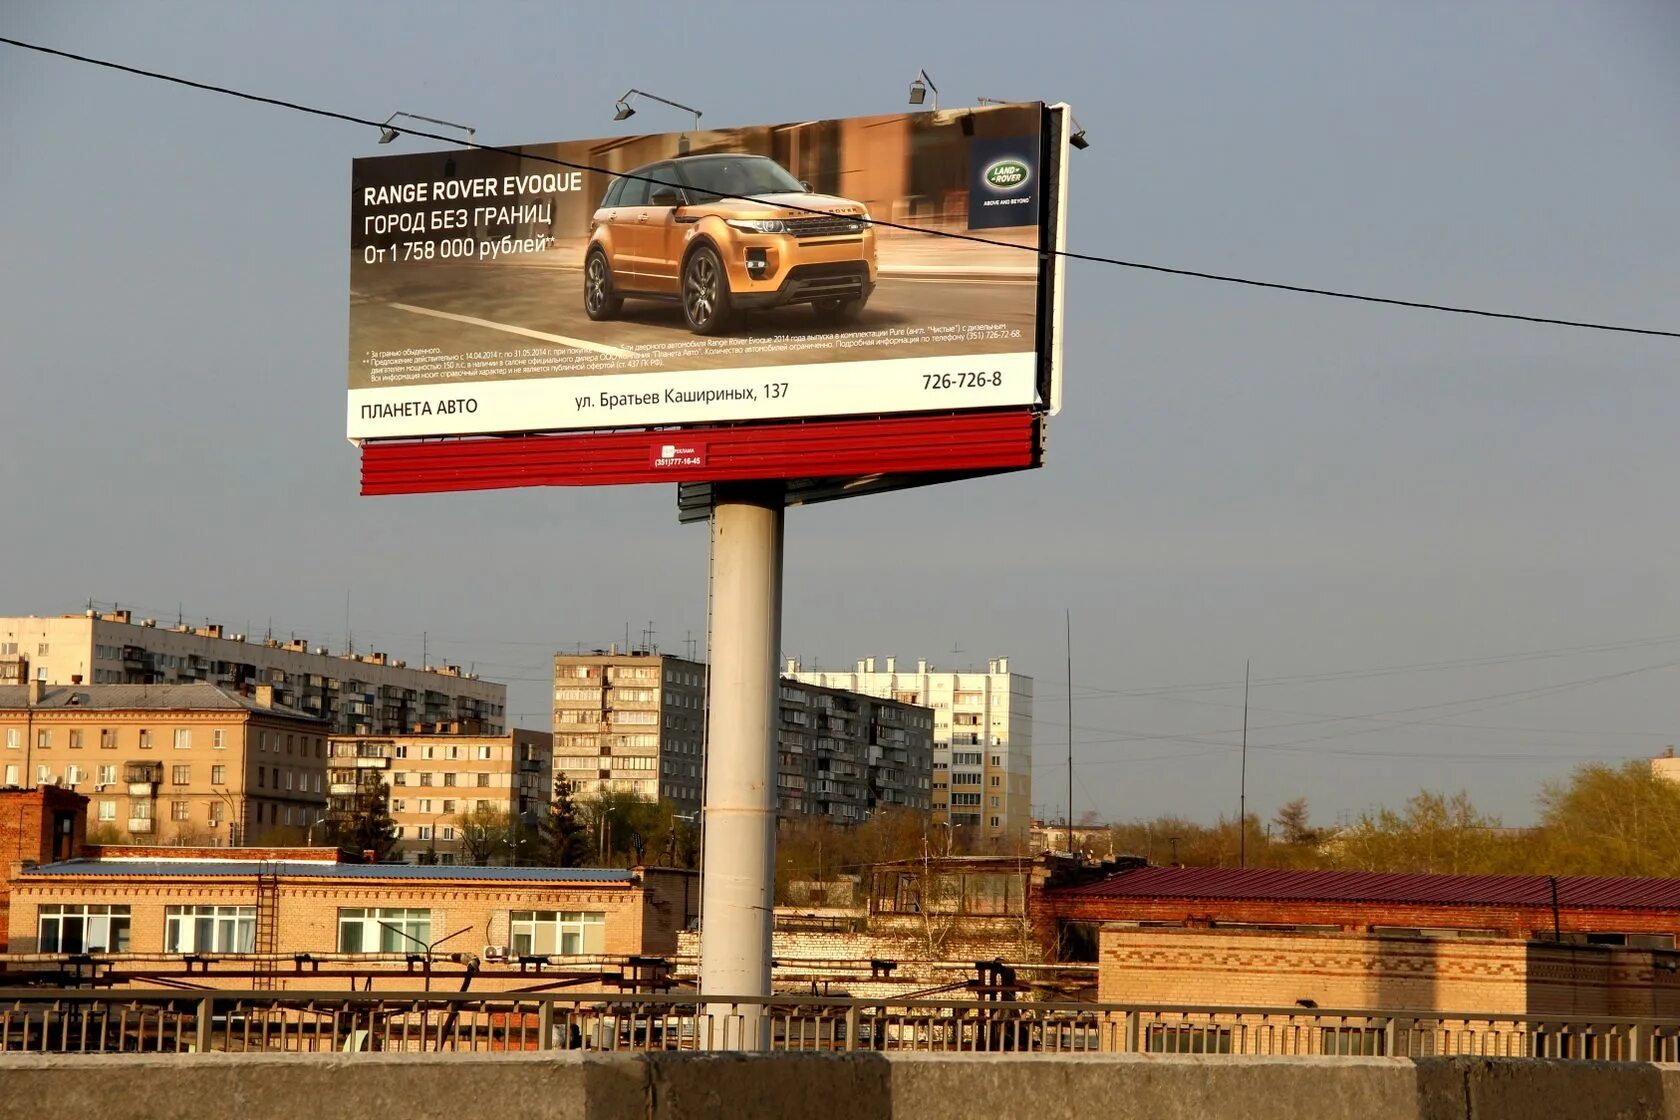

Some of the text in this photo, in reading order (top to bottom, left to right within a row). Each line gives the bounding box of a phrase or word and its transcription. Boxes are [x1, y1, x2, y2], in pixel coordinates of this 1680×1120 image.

[994, 166, 1015, 175] LAND
[996, 174, 1021, 183] ROVER
[364, 172, 582, 206] RANGE ROVER EVOQUE
[365, 203, 552, 235] ГОРОД БЕЗ ГРАНИЦ
[364, 245, 386, 264] От
[390, 243, 397, 262] 1
[403, 240, 435, 261] 758
[440, 238, 475, 258] 000
[371, 358, 413, 367] Предложение
[466, 351, 497, 360] 14.04.2014
[514, 348, 546, 358] 31.05.2014
[634, 343, 666, 351] дверного
[667, 340, 706, 349] автомобиля
[708, 338, 728, 348] Range
[728, 338, 748, 346] Rover
[748, 336, 772, 345] Evoque
[774, 335, 789, 344] 2014
[807, 334, 834, 342] выпуска
[840, 330, 888, 340] комплектации
[890, 328, 904, 336] Pure
[967, 323, 1007, 332] дизельным
[379, 350, 401, 358] гранью
[406, 364, 442, 374] мощностью
[528, 356, 574, 366] официального
[575, 354, 598, 363] дилера
[600, 353, 618, 361] ООО
[704, 346, 744, 356] Количество
[744, 344, 788, 353] автомобилей
[836, 339, 875, 348] Подробная
[876, 336, 920, 346] информация
[932, 333, 966, 342] телефону
[966, 332, 984, 340] (351)
[986, 330, 1022, 338] 726-72-68.
[382, 372, 420, 382] информация
[479, 367, 507, 376] характер
[522, 365, 550, 373] является
[551, 362, 586, 372] публичной
[586, 360, 615, 370] офертой
[616, 360, 626, 369] (ст.
[628, 360, 640, 368] 437
[640, 359, 649, 367] ГК
[650, 358, 665, 367] РФ).
[922, 371, 1002, 390] 726-726-8
[361, 398, 478, 419] ПЛАНЕТА АВТО
[575, 382, 789, 411] ул. Братьев Кашириных, 137
